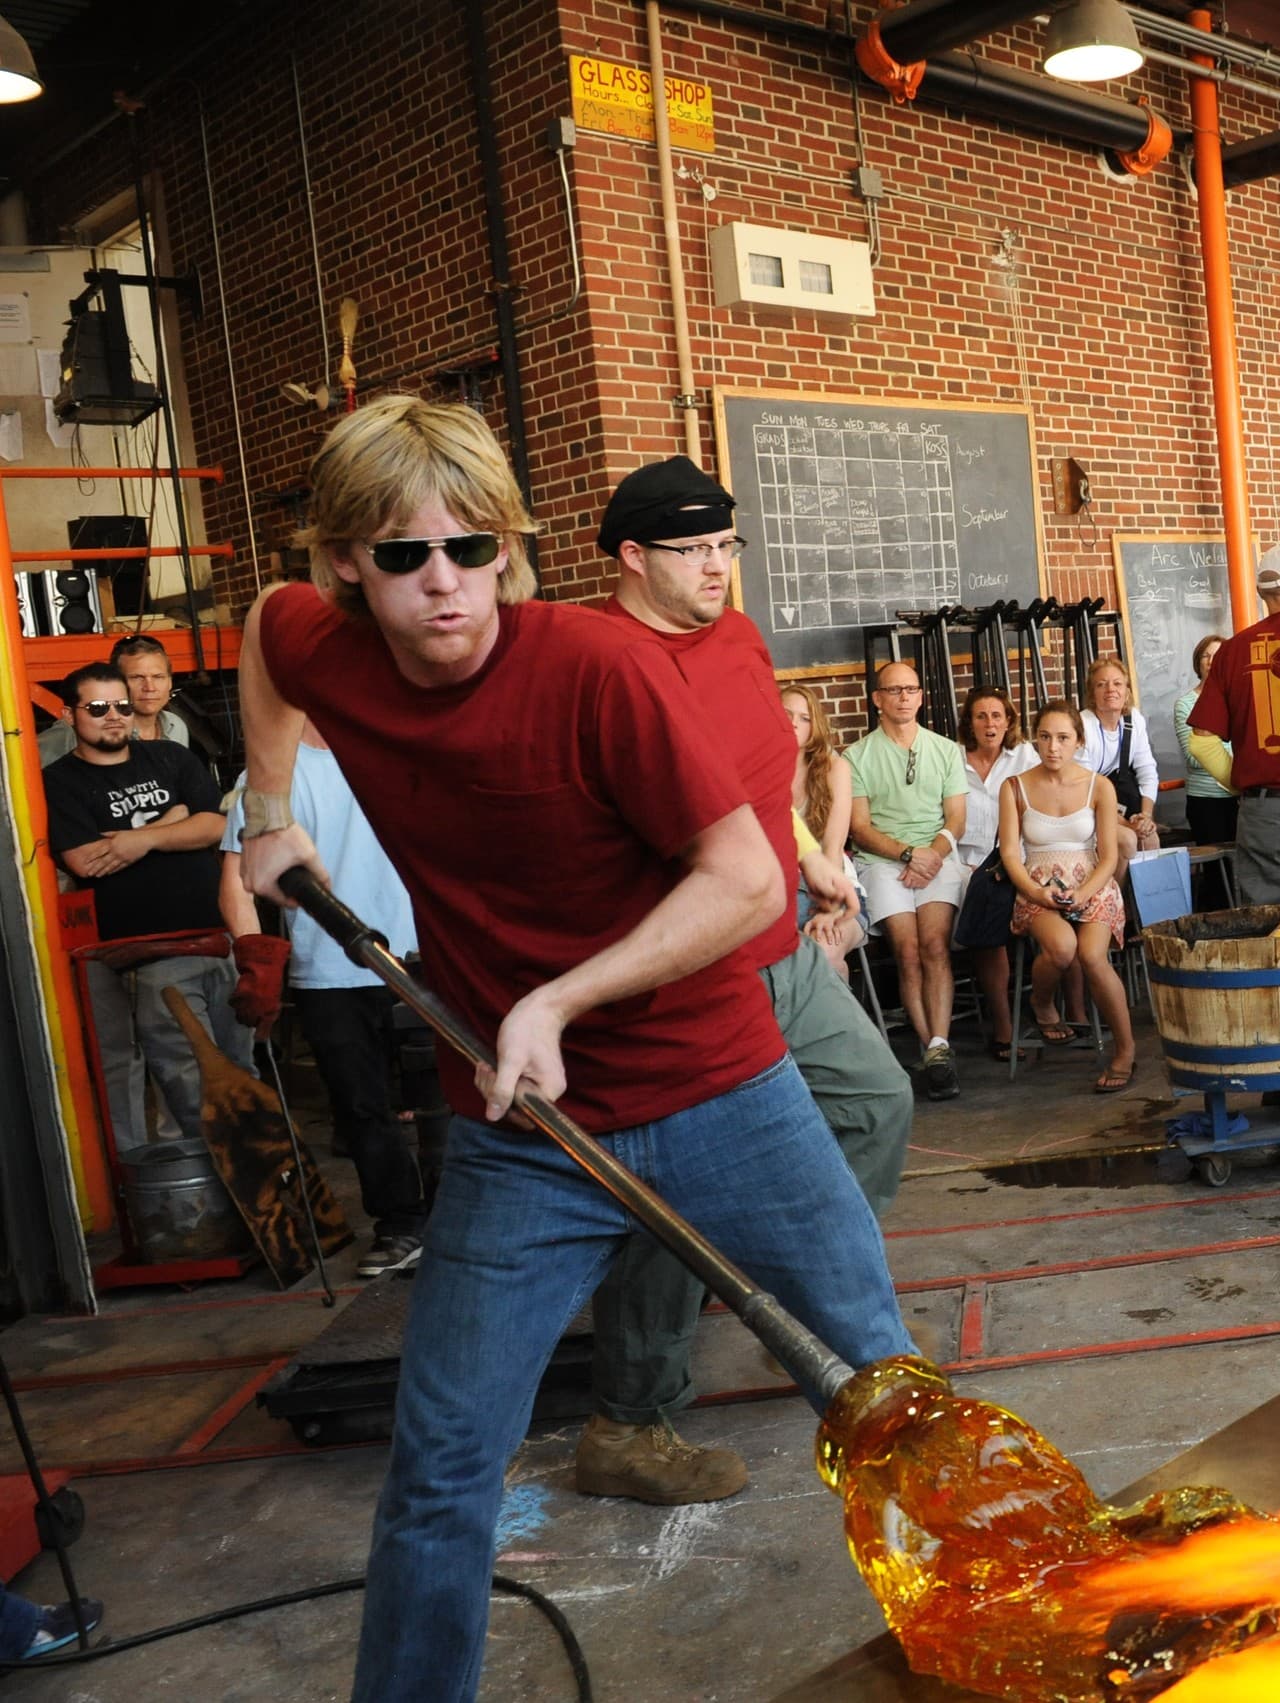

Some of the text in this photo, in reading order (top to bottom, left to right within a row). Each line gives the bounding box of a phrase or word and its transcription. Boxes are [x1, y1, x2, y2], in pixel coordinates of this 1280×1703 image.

[579, 60, 705, 107] GLASS SHOP
[761, 411, 783, 425] SUN
[789, 414, 808, 427] MON
[814, 415, 838, 428] TUES
[843, 418, 864, 431] WED
[896, 422, 910, 434] FRI
[920, 423, 941, 436] SAT
[757, 432, 785, 448] GRADS
[956, 442, 985, 464] August
[961, 503, 1009, 530] September
[1151, 544, 1180, 567] Arc
[124, 780, 159, 795] WITH
[110, 789, 170, 818] STUPID
